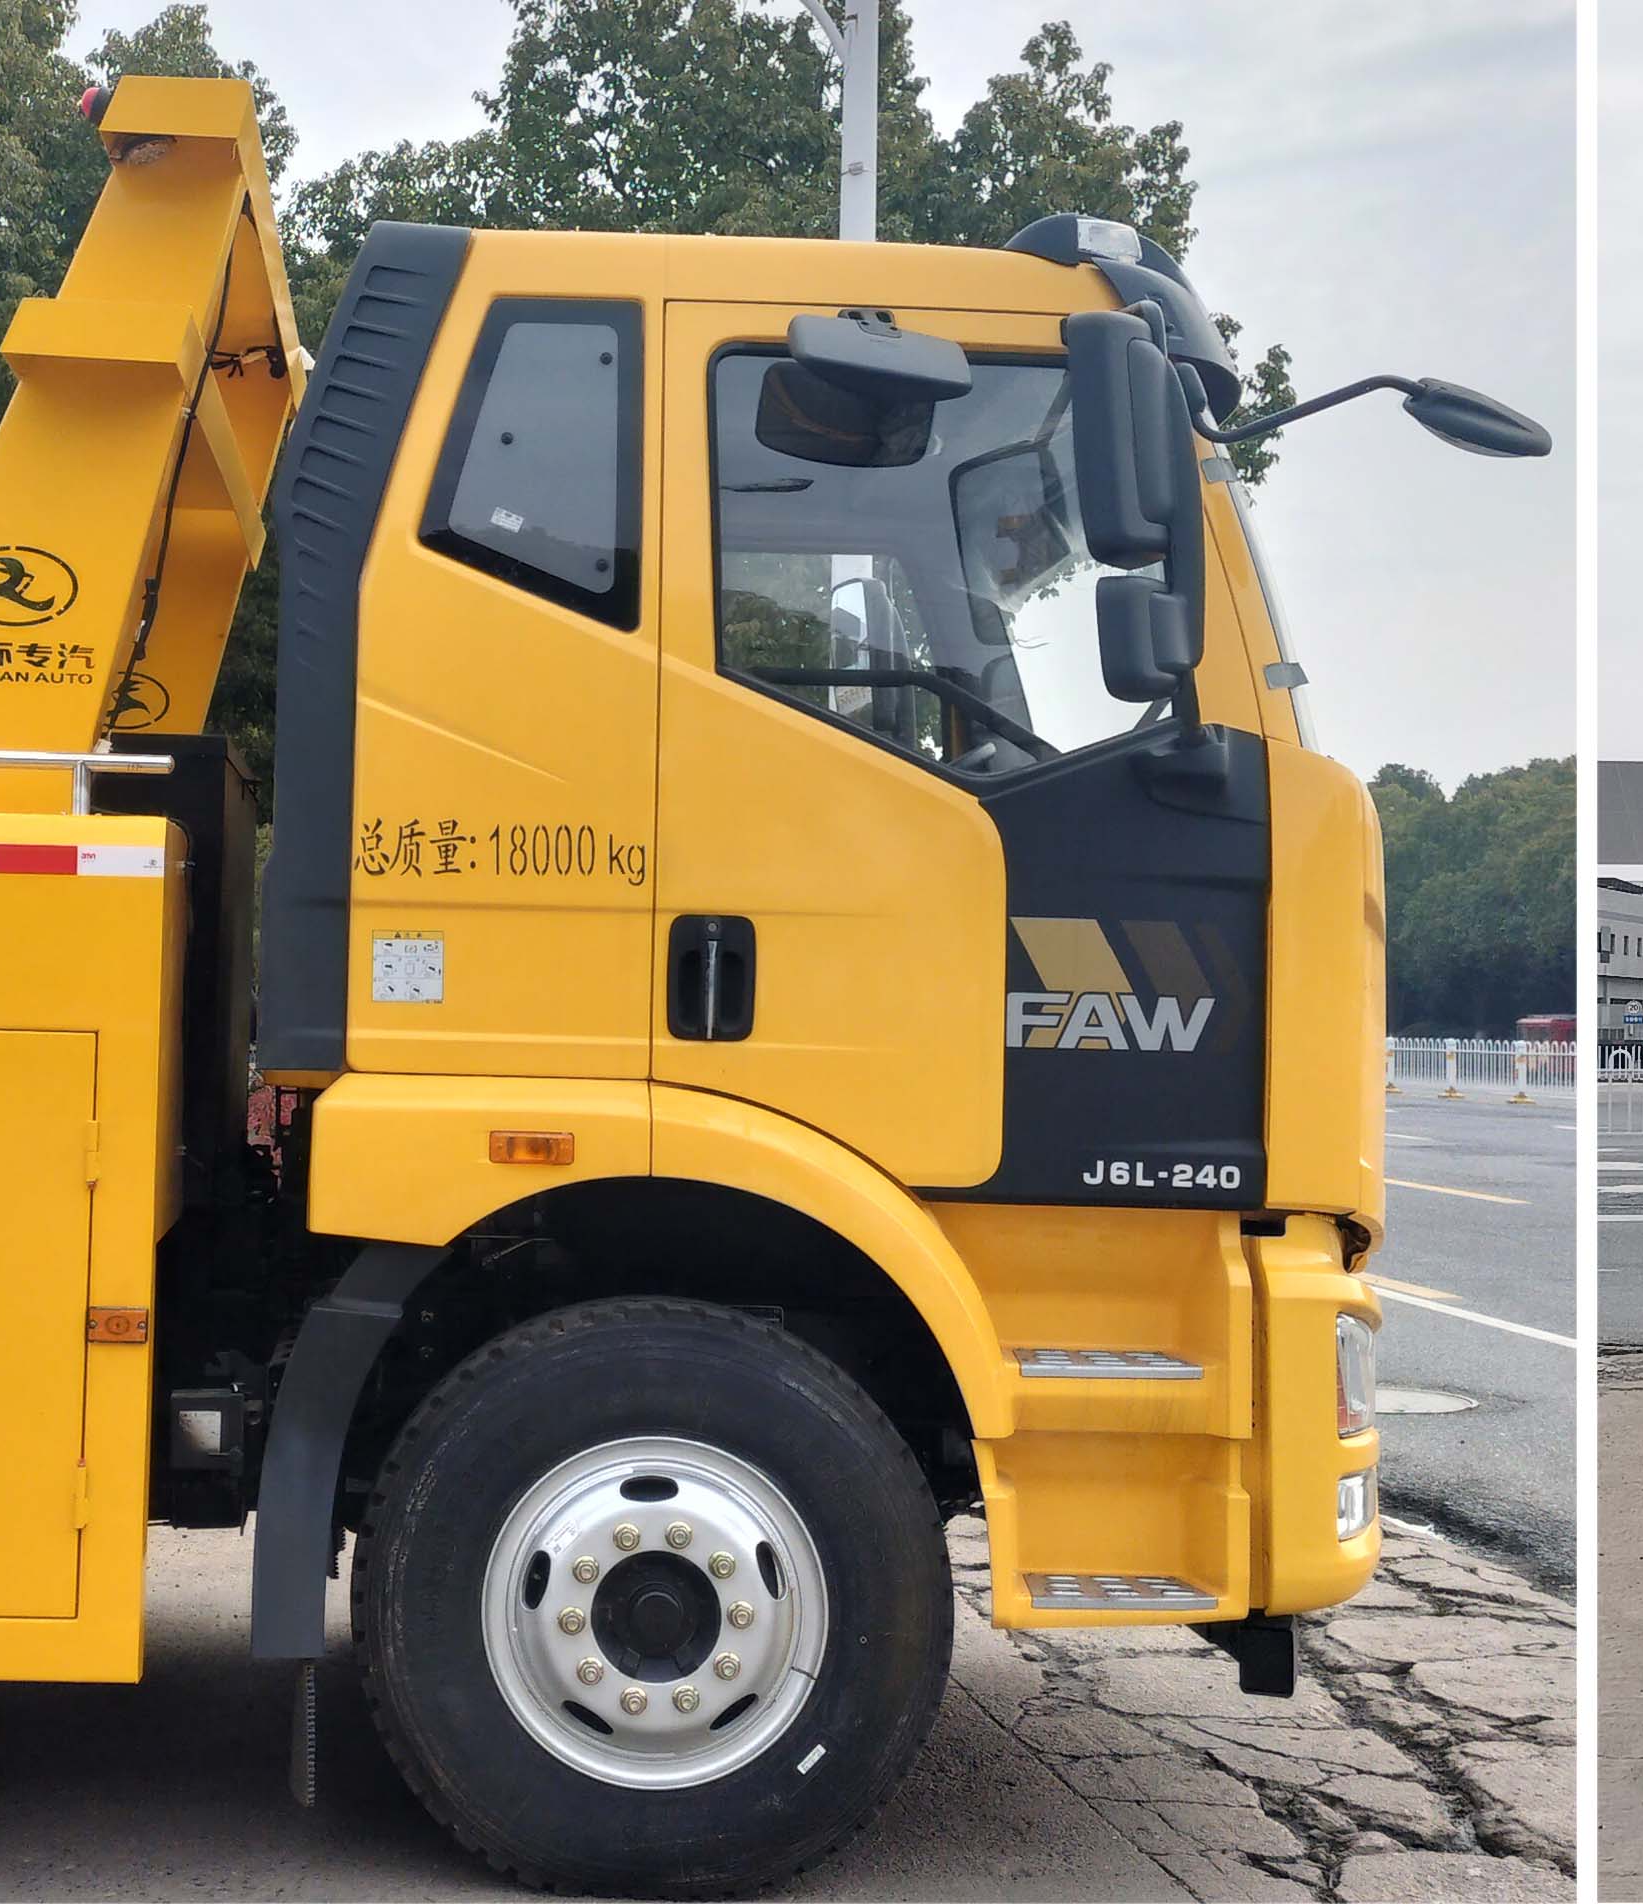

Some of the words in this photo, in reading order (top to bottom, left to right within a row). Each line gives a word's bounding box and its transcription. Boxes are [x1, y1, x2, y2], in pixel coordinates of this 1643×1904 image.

[34, 672, 93, 684] AUTO
[608, 833, 647, 886] kg
[1005, 992, 1216, 1052] FAW
[1082, 1160, 1242, 1190] J6L-240
